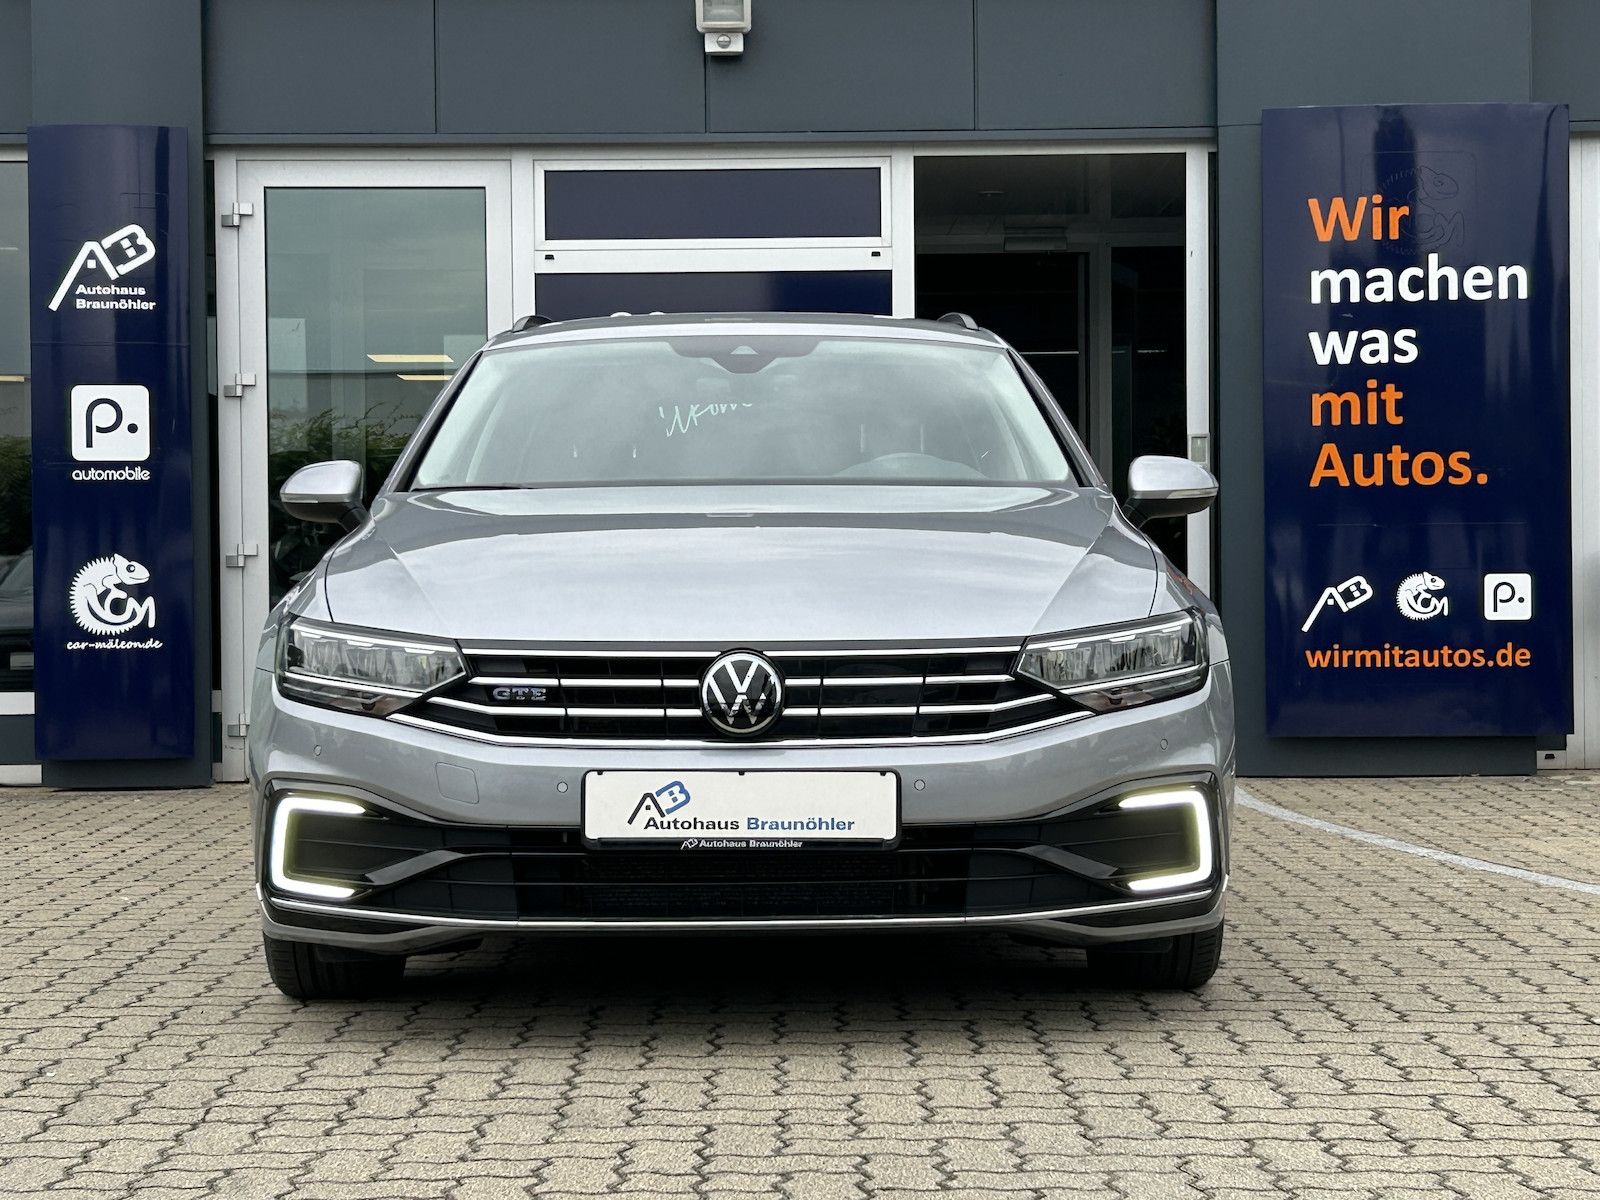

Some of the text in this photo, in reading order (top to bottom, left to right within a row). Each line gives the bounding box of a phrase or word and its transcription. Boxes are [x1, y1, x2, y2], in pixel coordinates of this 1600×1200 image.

[1307, 194, 1410, 242] Wir
[1310, 252, 1528, 304] machen
[75, 284, 146, 296] Autohaus
[75, 298, 156, 310] Braunöhler
[1308, 327, 1419, 366] was
[1310, 378, 1404, 426] mit
[1308, 443, 1489, 488] Autos.
[71, 466, 151, 482] automobile
[66, 638, 163, 650] car-mäleon.de
[1304, 642, 1532, 668] wirmitautos.de
[492, 686, 547, 702] GTE
[643, 816, 855, 831] Autohaus Braunöhler
[699, 840, 747, 848] Autohaus
[749, 839, 803, 848] Braunöhler
